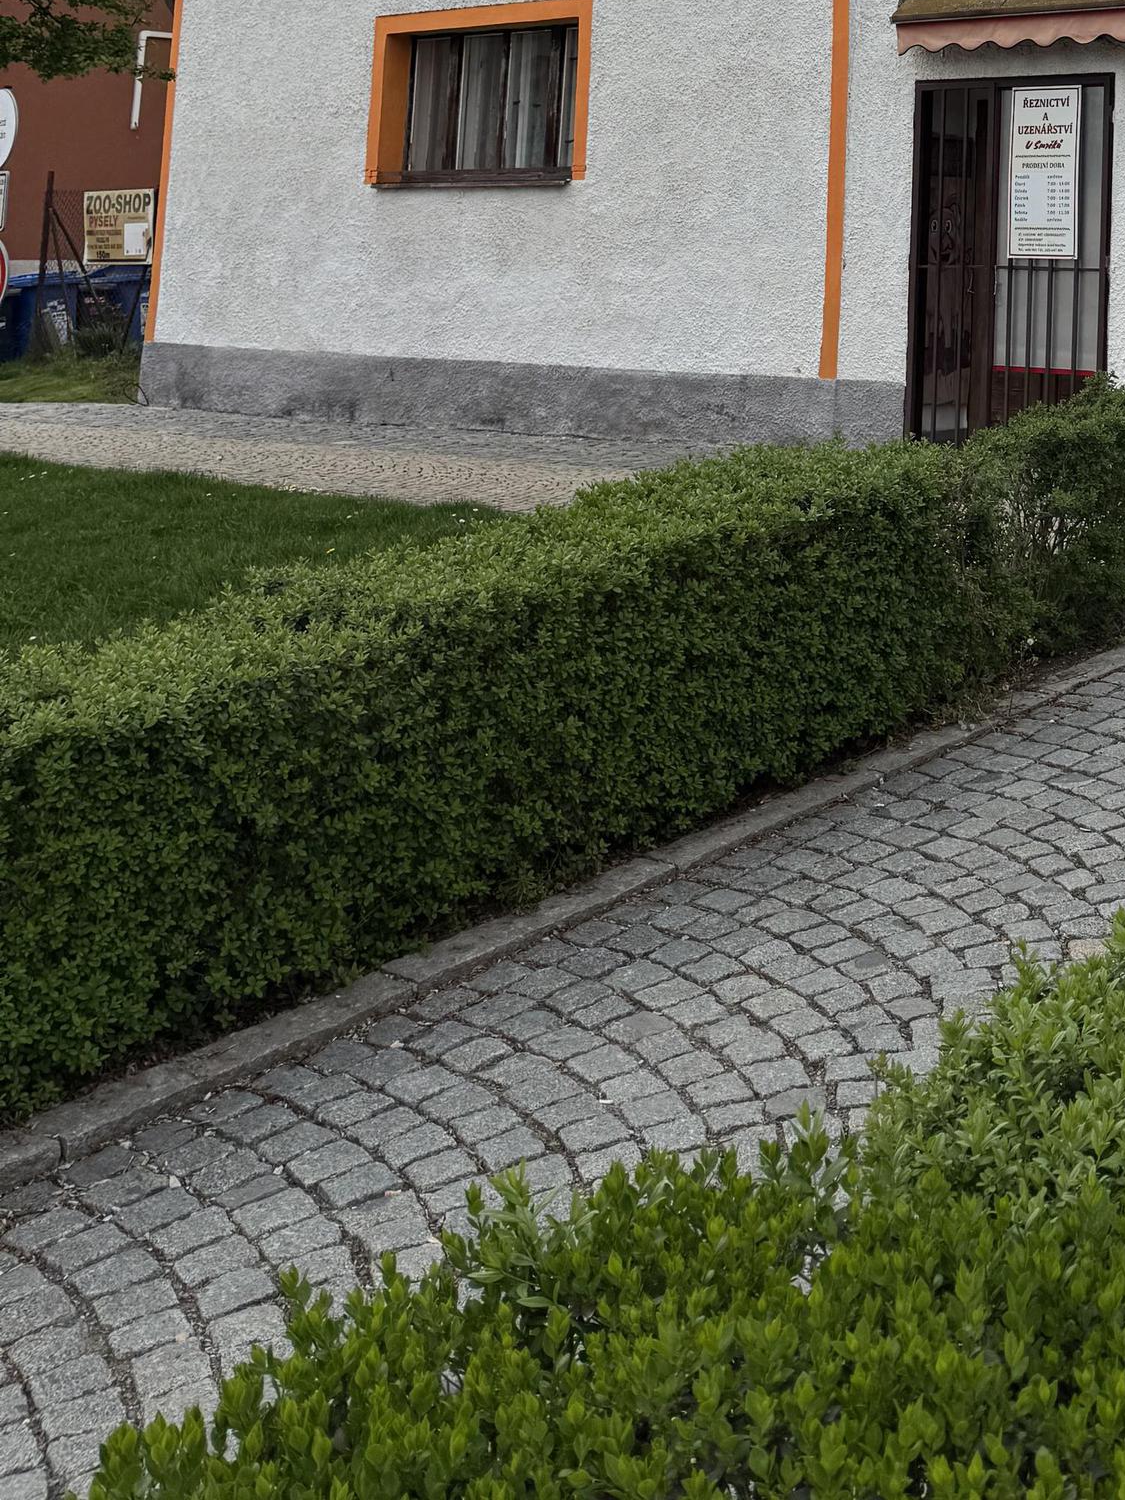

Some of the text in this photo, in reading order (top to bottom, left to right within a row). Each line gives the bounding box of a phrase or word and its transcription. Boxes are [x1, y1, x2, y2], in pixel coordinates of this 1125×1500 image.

[1023, 96, 1070, 108] ŘEZNICTVÍ
[1043, 112, 1049, 121] A
[1018, 123, 1073, 135] UZENÁŘSTVÍ
[1025, 141, 1033, 150] U
[86, 193, 151, 214] ZOO-SHOP
